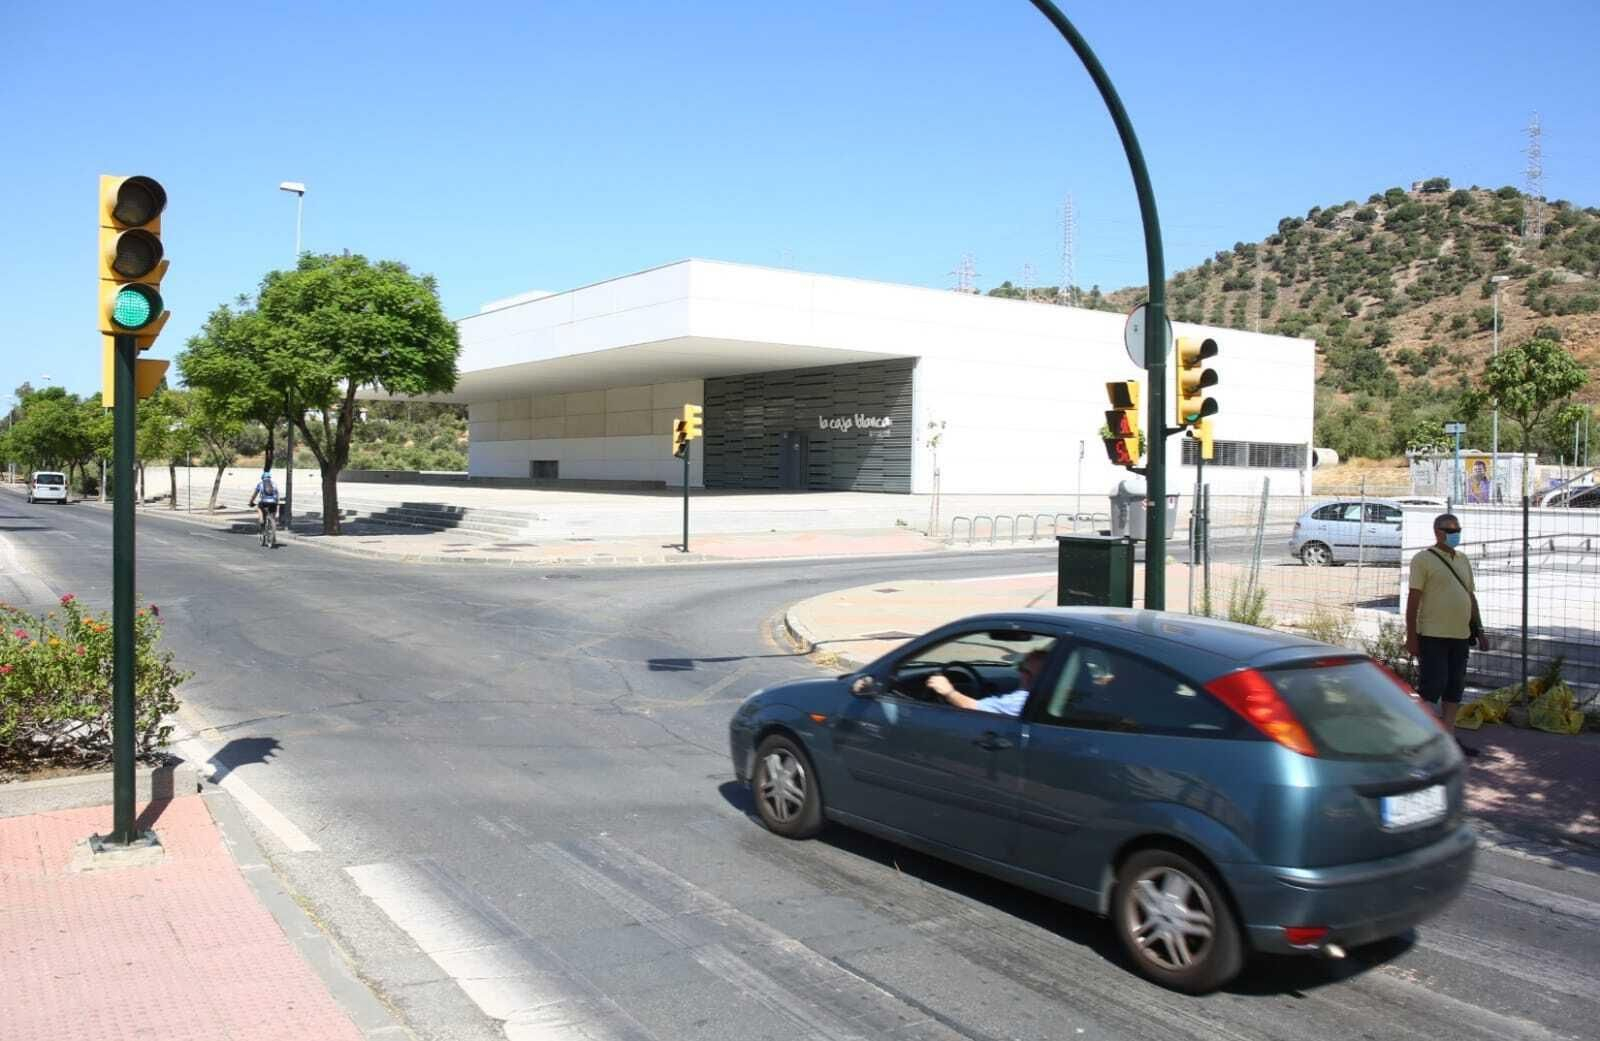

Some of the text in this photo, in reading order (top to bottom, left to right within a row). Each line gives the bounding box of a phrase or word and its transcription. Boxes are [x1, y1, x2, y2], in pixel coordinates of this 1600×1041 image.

[818, 413, 892, 432] la caja blanca
